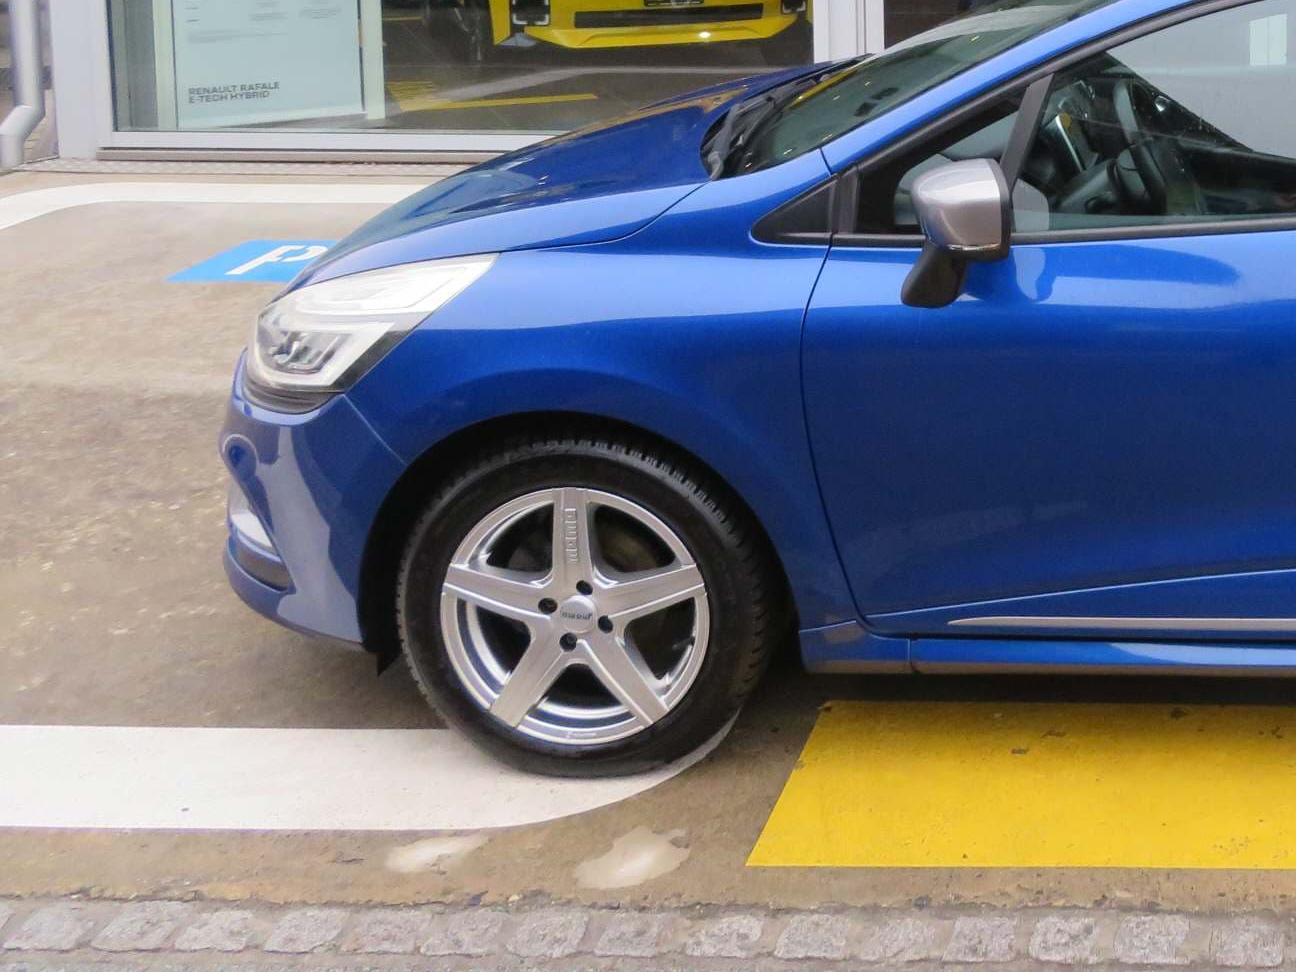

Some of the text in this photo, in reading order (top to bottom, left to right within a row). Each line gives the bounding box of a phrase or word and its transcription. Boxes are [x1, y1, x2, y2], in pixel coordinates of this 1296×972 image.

[188, 81, 280, 95] RENAULT RAFALE
[188, 90, 270, 104] E-TECH HYBRID
